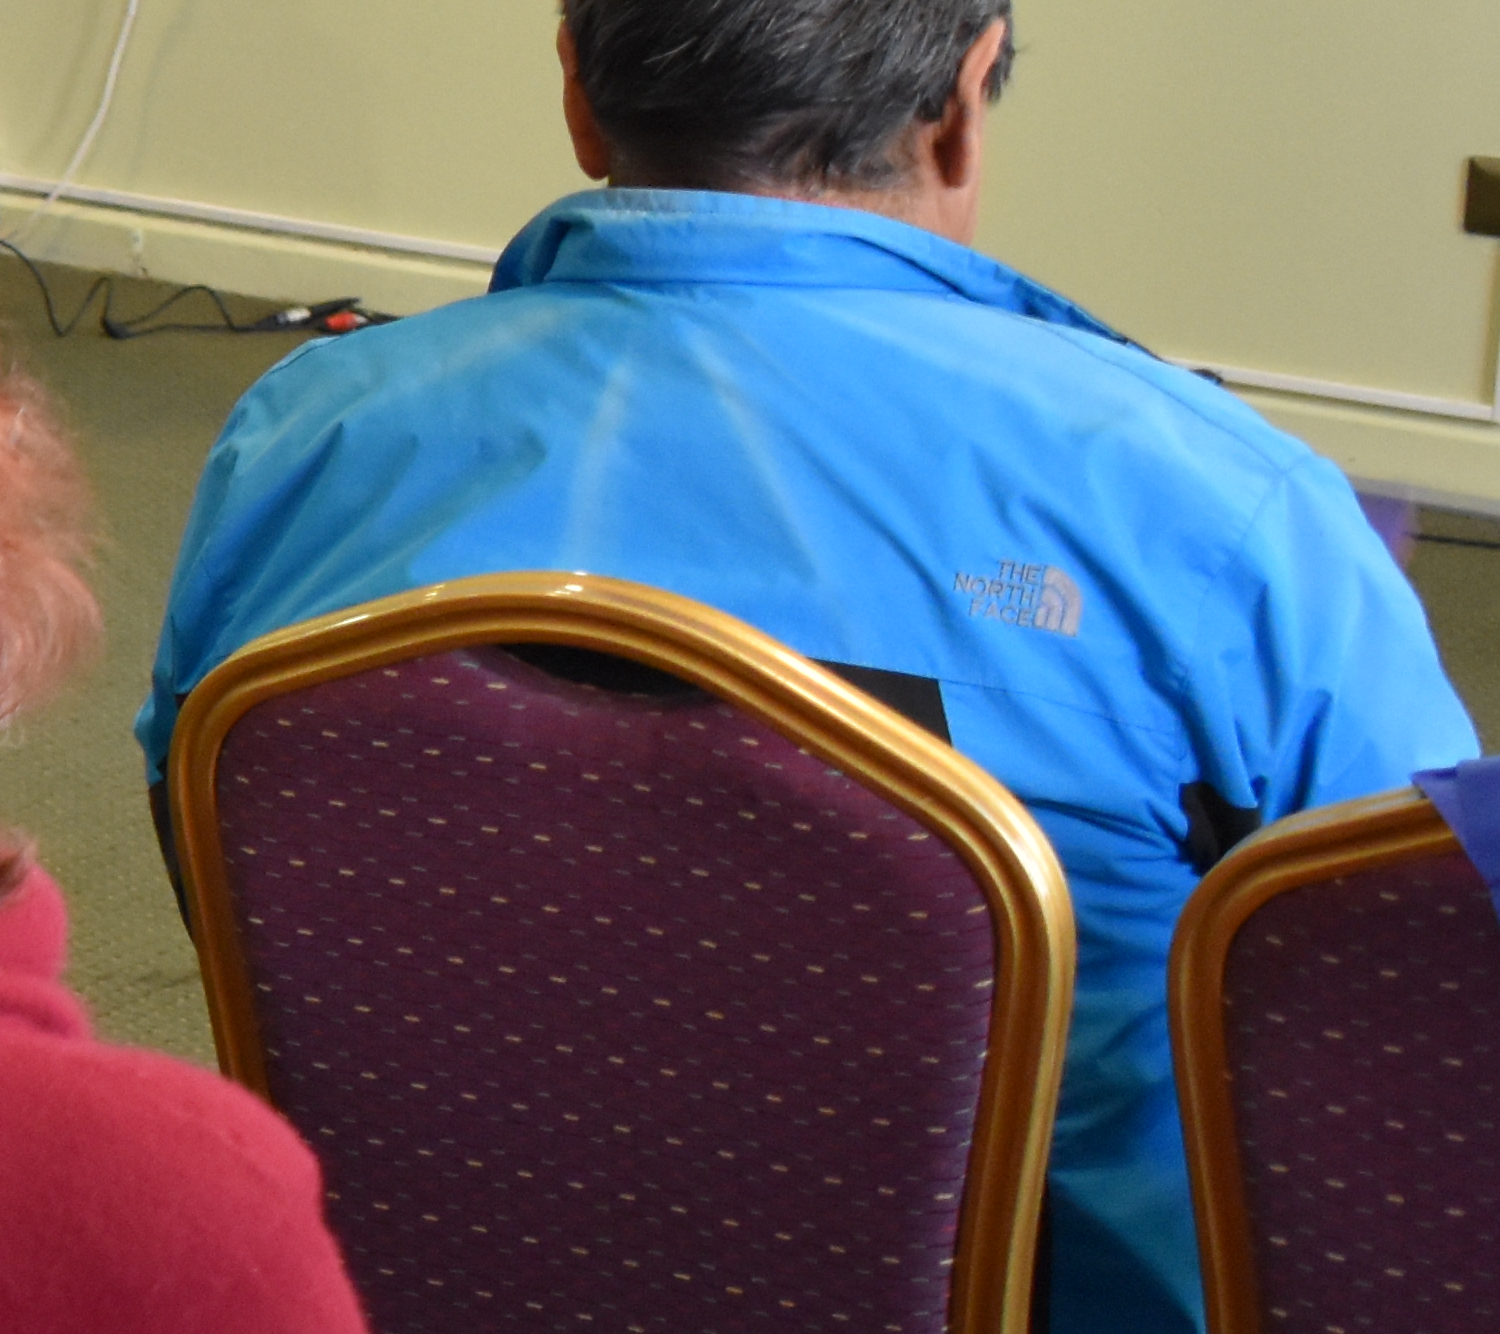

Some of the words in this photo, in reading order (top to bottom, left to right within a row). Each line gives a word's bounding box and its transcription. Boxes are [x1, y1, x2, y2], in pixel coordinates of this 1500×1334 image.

[998, 559, 1041, 586] THE
[953, 571, 1040, 608] NORTH
[968, 598, 1033, 627] FACE
